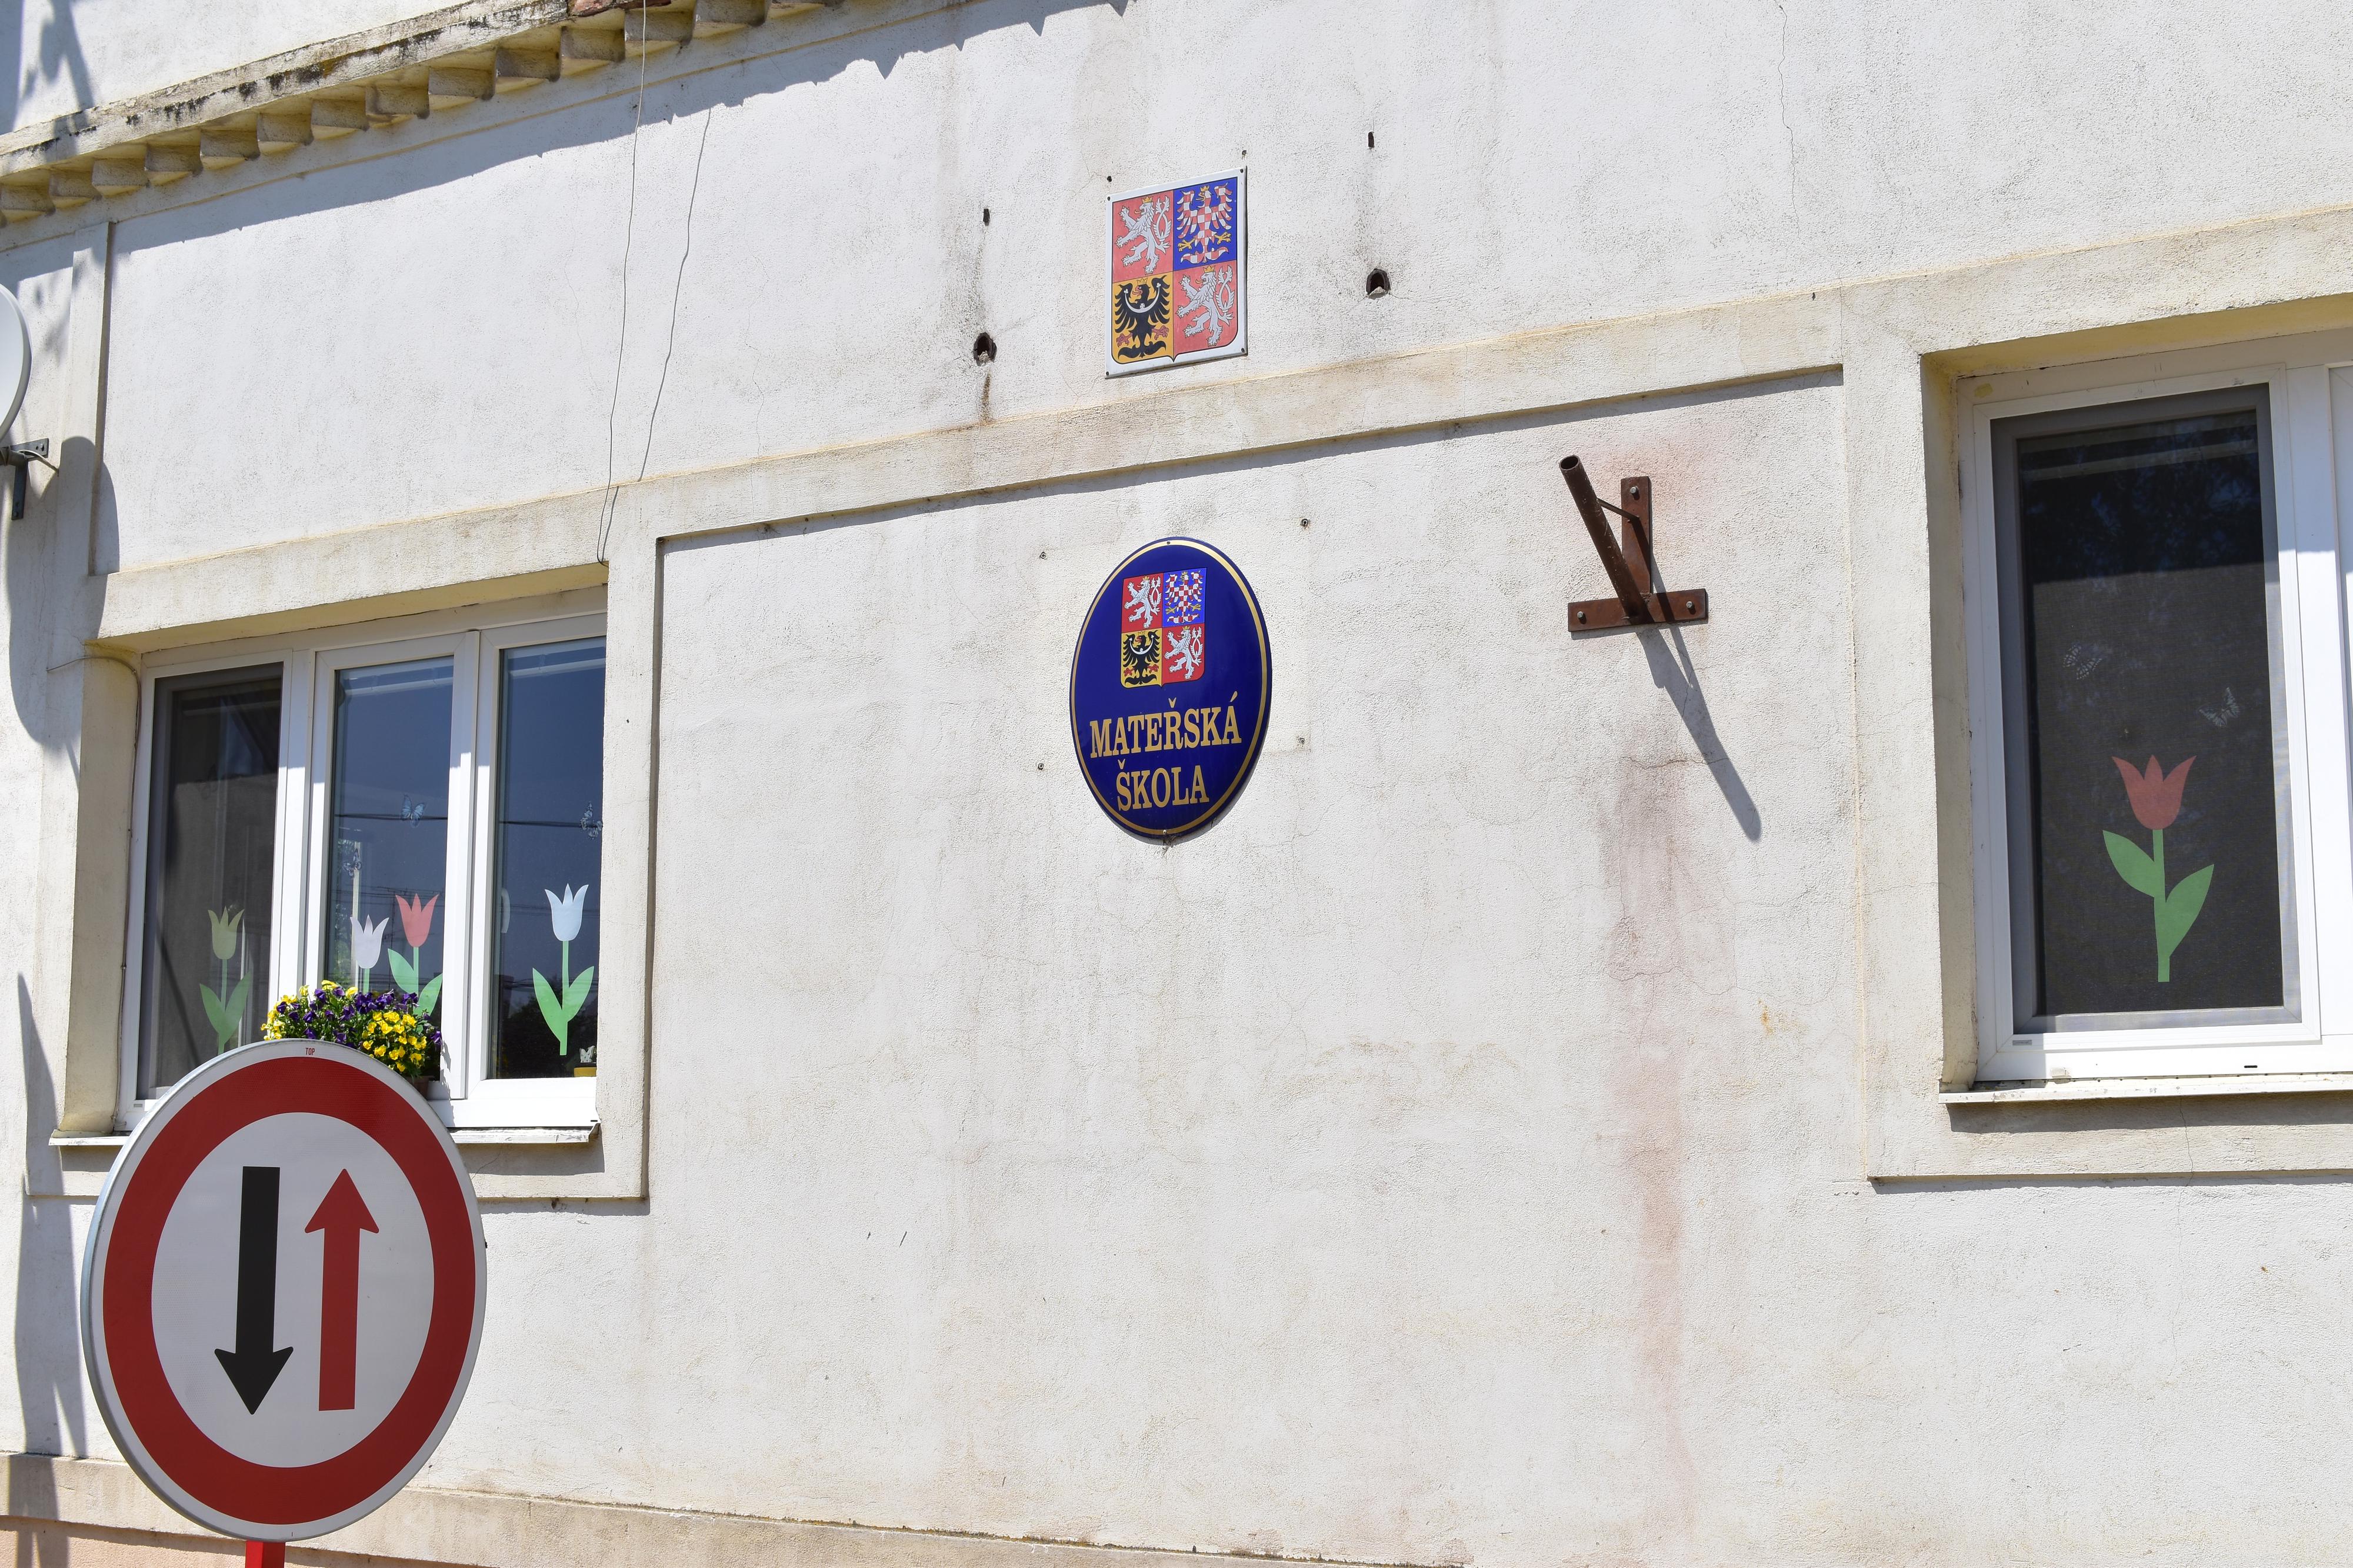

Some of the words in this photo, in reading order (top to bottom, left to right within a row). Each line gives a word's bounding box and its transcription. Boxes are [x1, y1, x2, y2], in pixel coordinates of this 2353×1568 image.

[1089, 690, 1242, 759] MATEŘSKÁ
[1116, 758, 1210, 812] ŠKOLA
[305, 1047, 315, 1056] TOP
